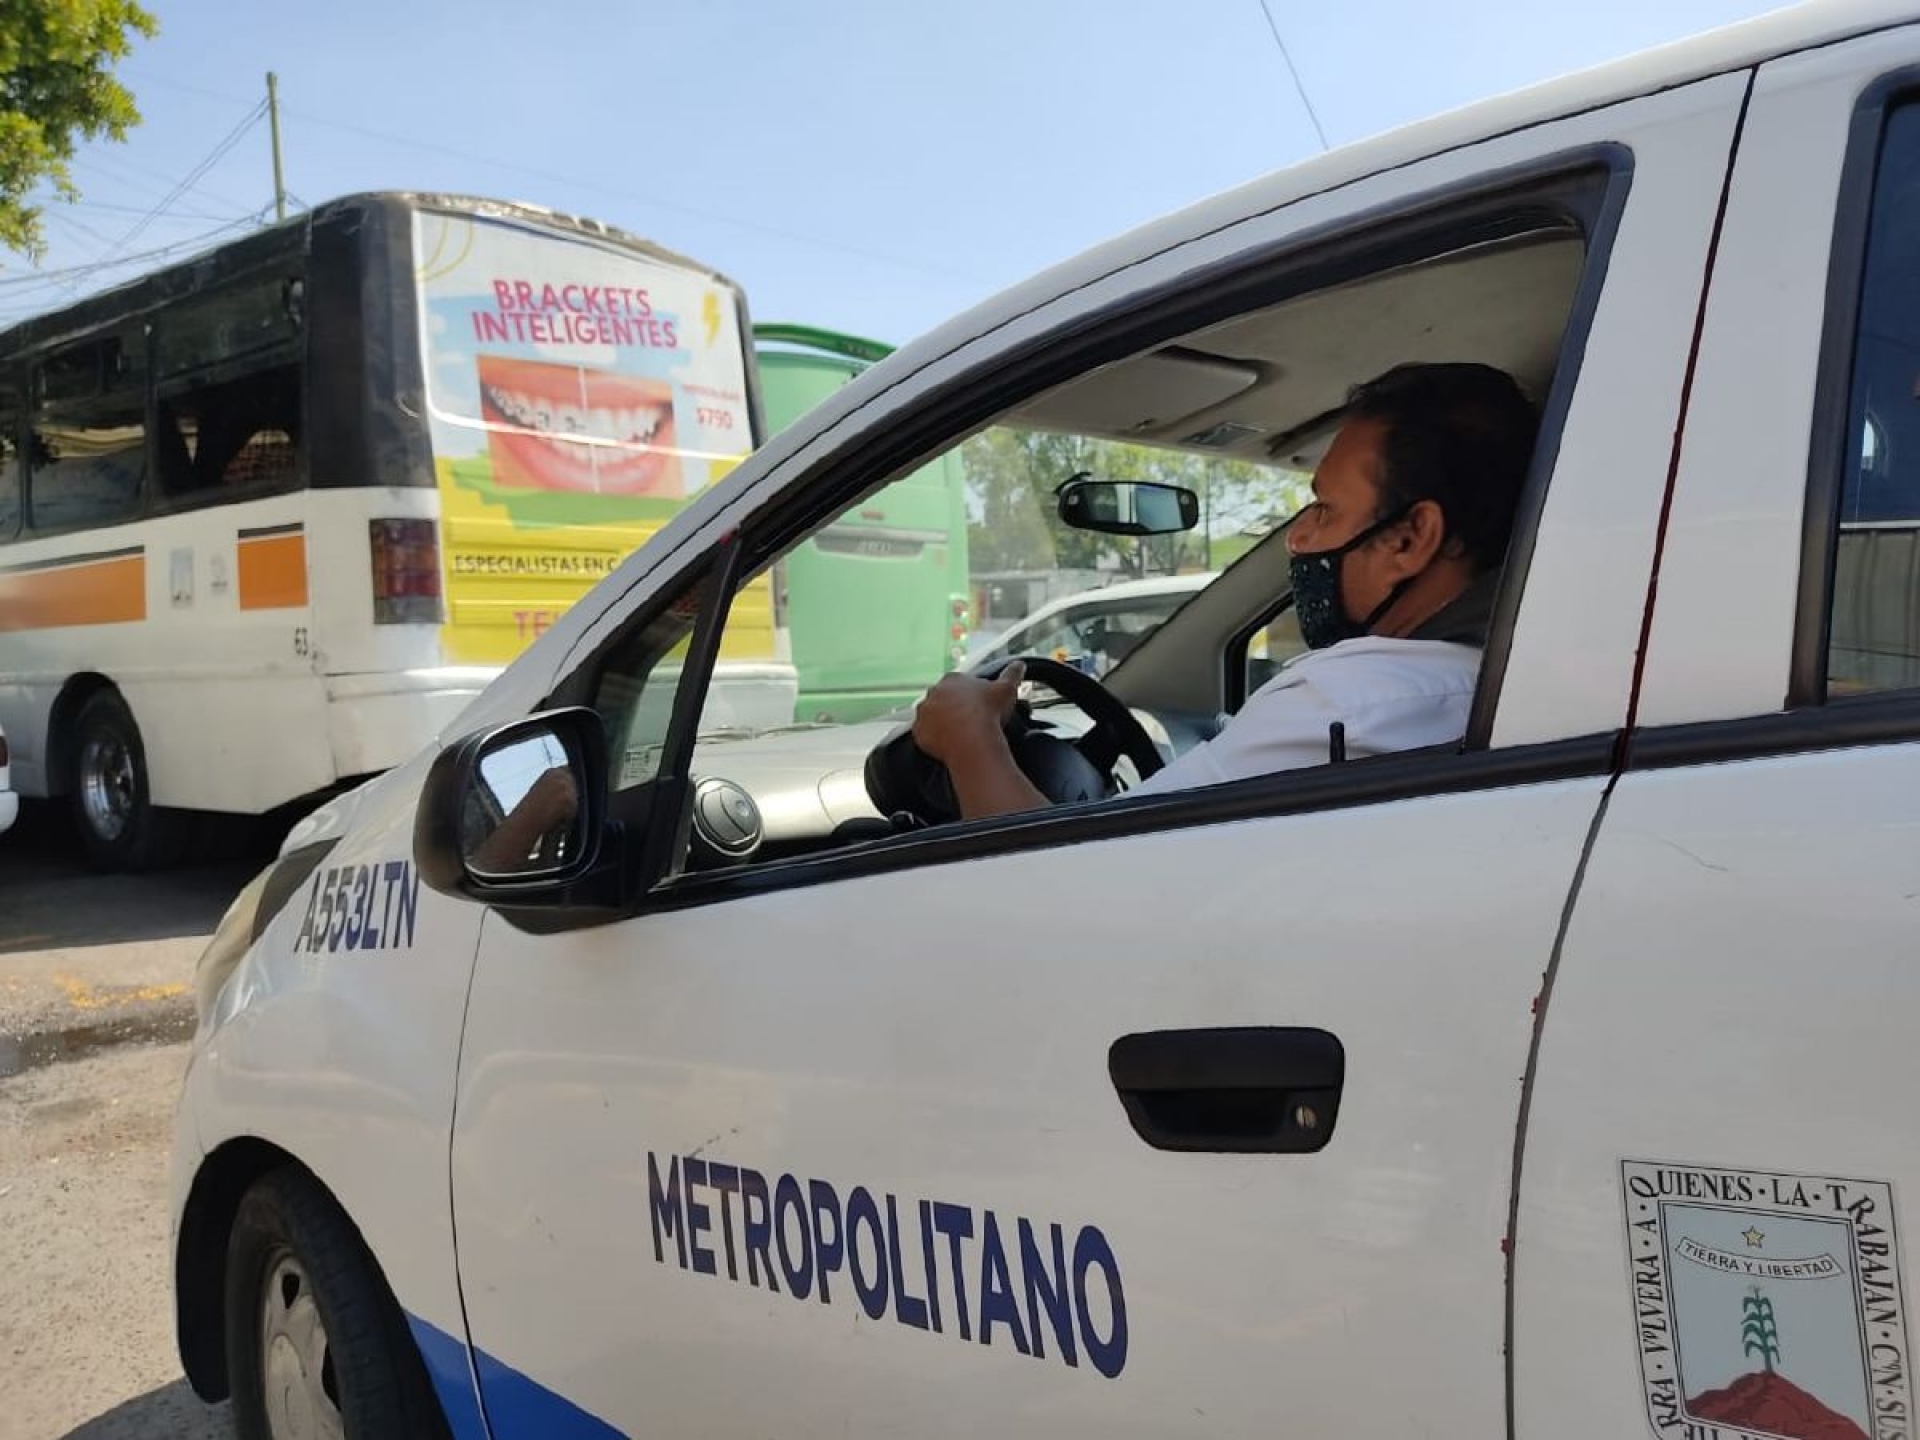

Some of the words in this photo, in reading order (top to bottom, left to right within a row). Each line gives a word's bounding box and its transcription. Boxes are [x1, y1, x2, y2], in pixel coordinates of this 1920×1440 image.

[493, 279, 651, 317] BRACKETS
[471, 311, 678, 348] INTELIGENTES
[455, 555, 579, 574] ESPECIALISTAS
[584, 558, 604, 573] EN
[294, 859, 419, 953] A553LTN
[1629, 1169, 1753, 1201] QUIENES
[1772, 1178, 1811, 1208] LA
[647, 1151, 1129, 1379] METROPOLITANO
[1685, 1242, 1739, 1270] TIERRA
[1743, 1261, 1753, 1273] Y
[1758, 1259, 1833, 1277] LIBERTAD
